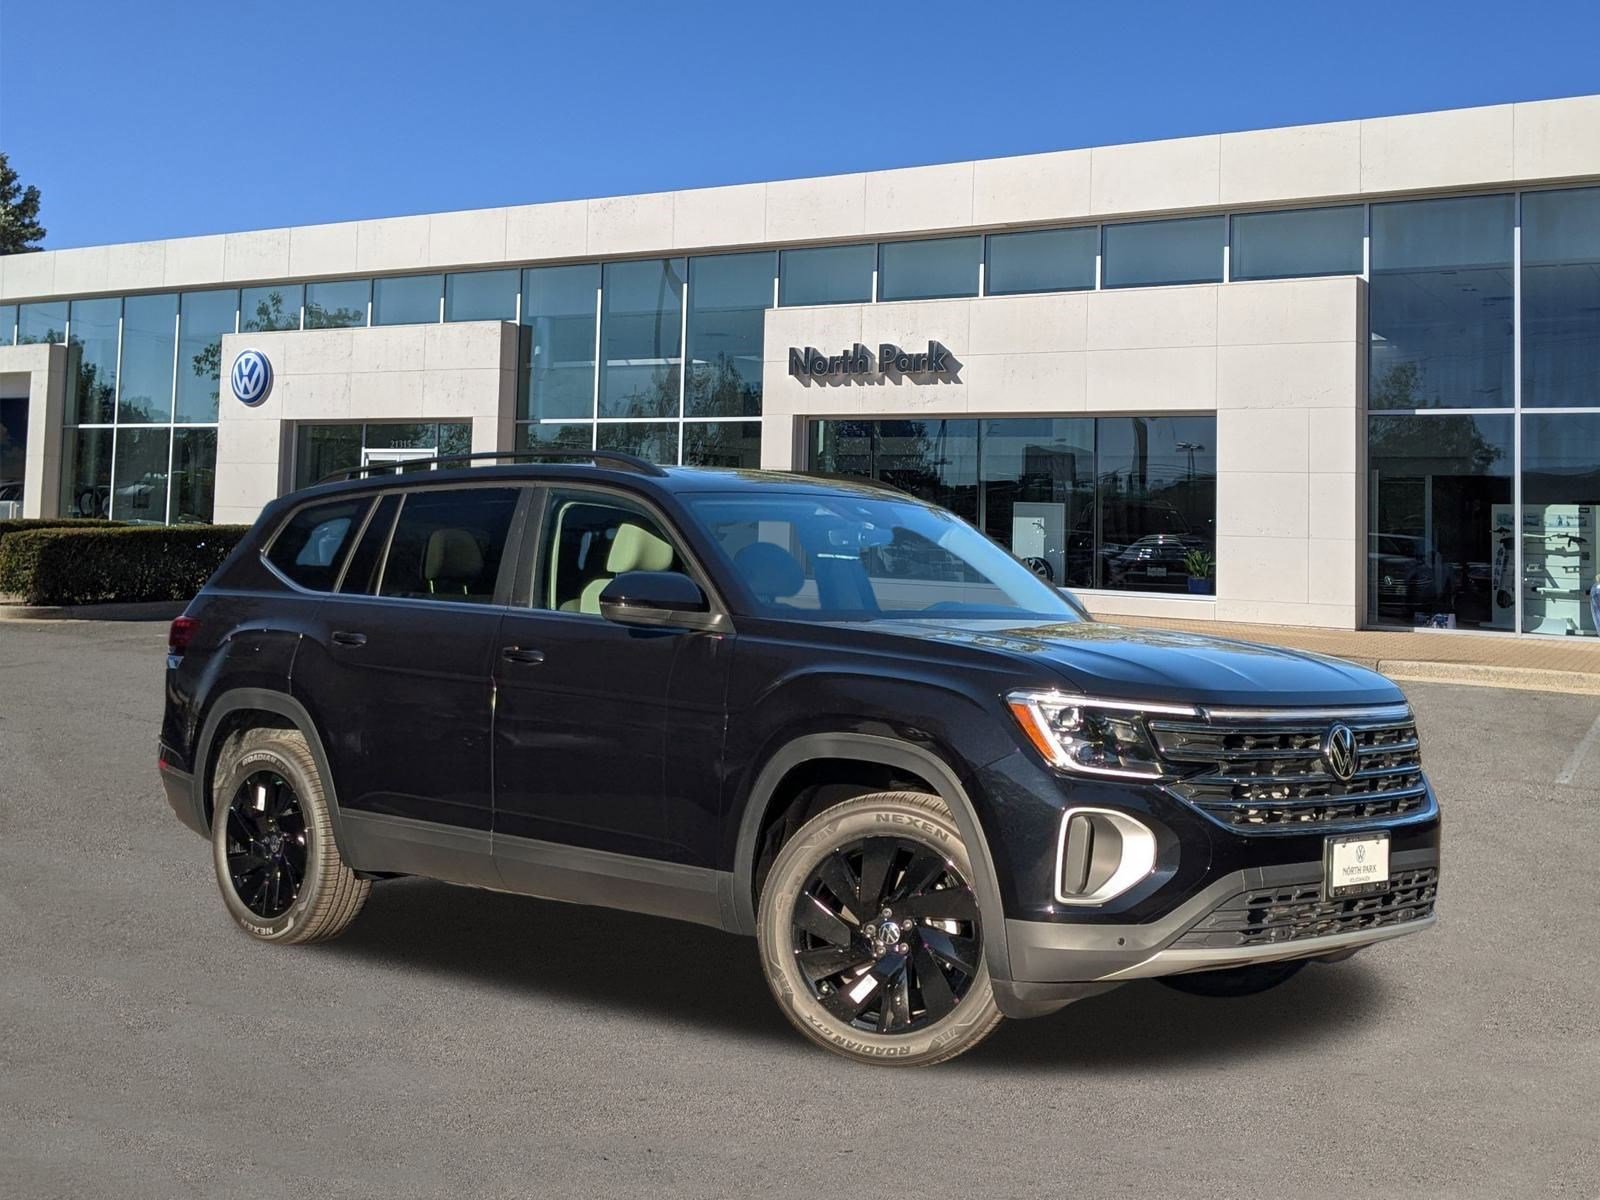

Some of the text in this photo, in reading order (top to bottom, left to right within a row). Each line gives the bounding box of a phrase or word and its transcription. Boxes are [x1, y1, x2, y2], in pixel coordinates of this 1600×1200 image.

[788, 340, 948, 377] North Park
[876, 814, 949, 842] NEXEN
[1342, 866, 1362, 876] NORTH
[833, 1035, 911, 1056] ROADIAN
